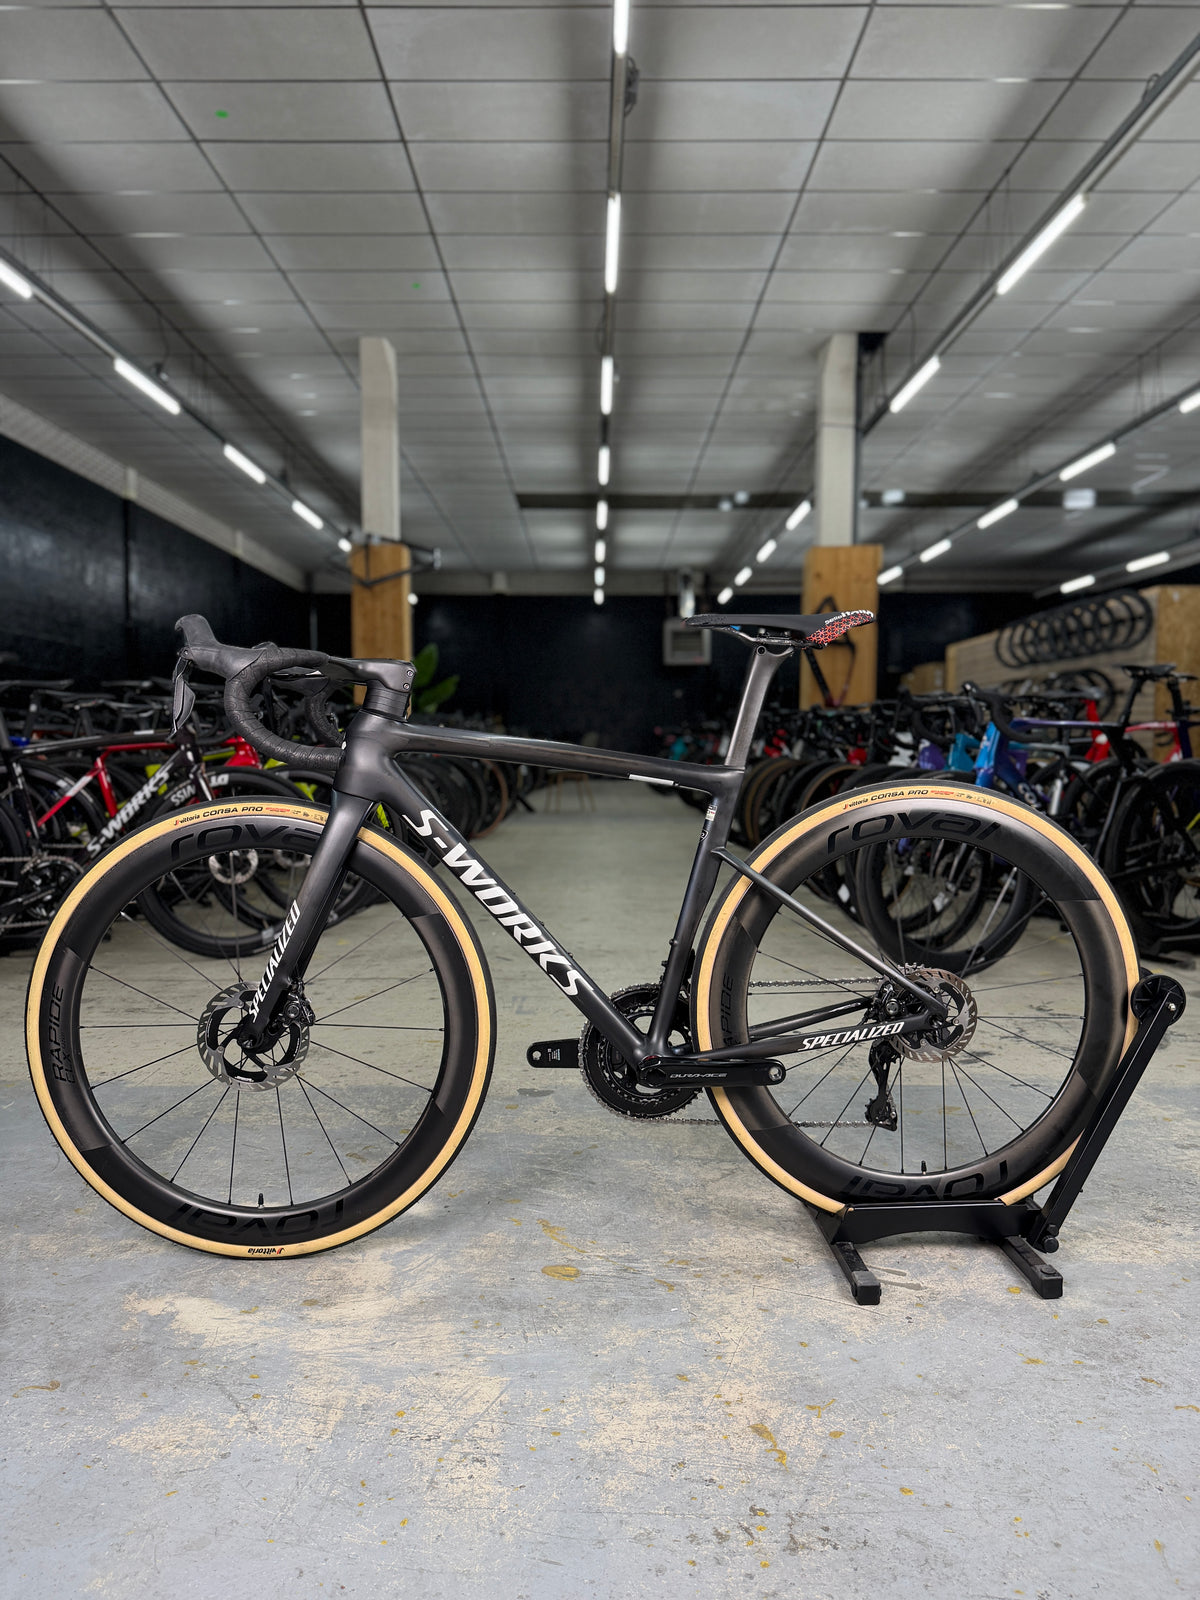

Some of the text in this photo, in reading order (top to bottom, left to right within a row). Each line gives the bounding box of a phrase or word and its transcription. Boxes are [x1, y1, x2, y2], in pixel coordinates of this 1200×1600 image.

[87, 750, 180, 859] S-WORKS
[170, 784, 197, 807] WISS
[848, 797, 869, 808] vittoria
[870, 791, 905, 801] CORSA
[179, 814, 201, 824] vittoria
[202, 807, 239, 818] CORSA
[827, 811, 1002, 855] roval
[170, 823, 323, 862] rova
[401, 809, 596, 996] S-WORKS
[249, 899, 301, 1023] SPECIALIZED
[720, 973, 734, 1046] APIDE
[48, 982, 67, 1082] RAPIDE
[798, 1021, 905, 1052] SPECIALIZED
[167, 1198, 344, 1237] roval
[247, 1247, 278, 1255] vittoria
